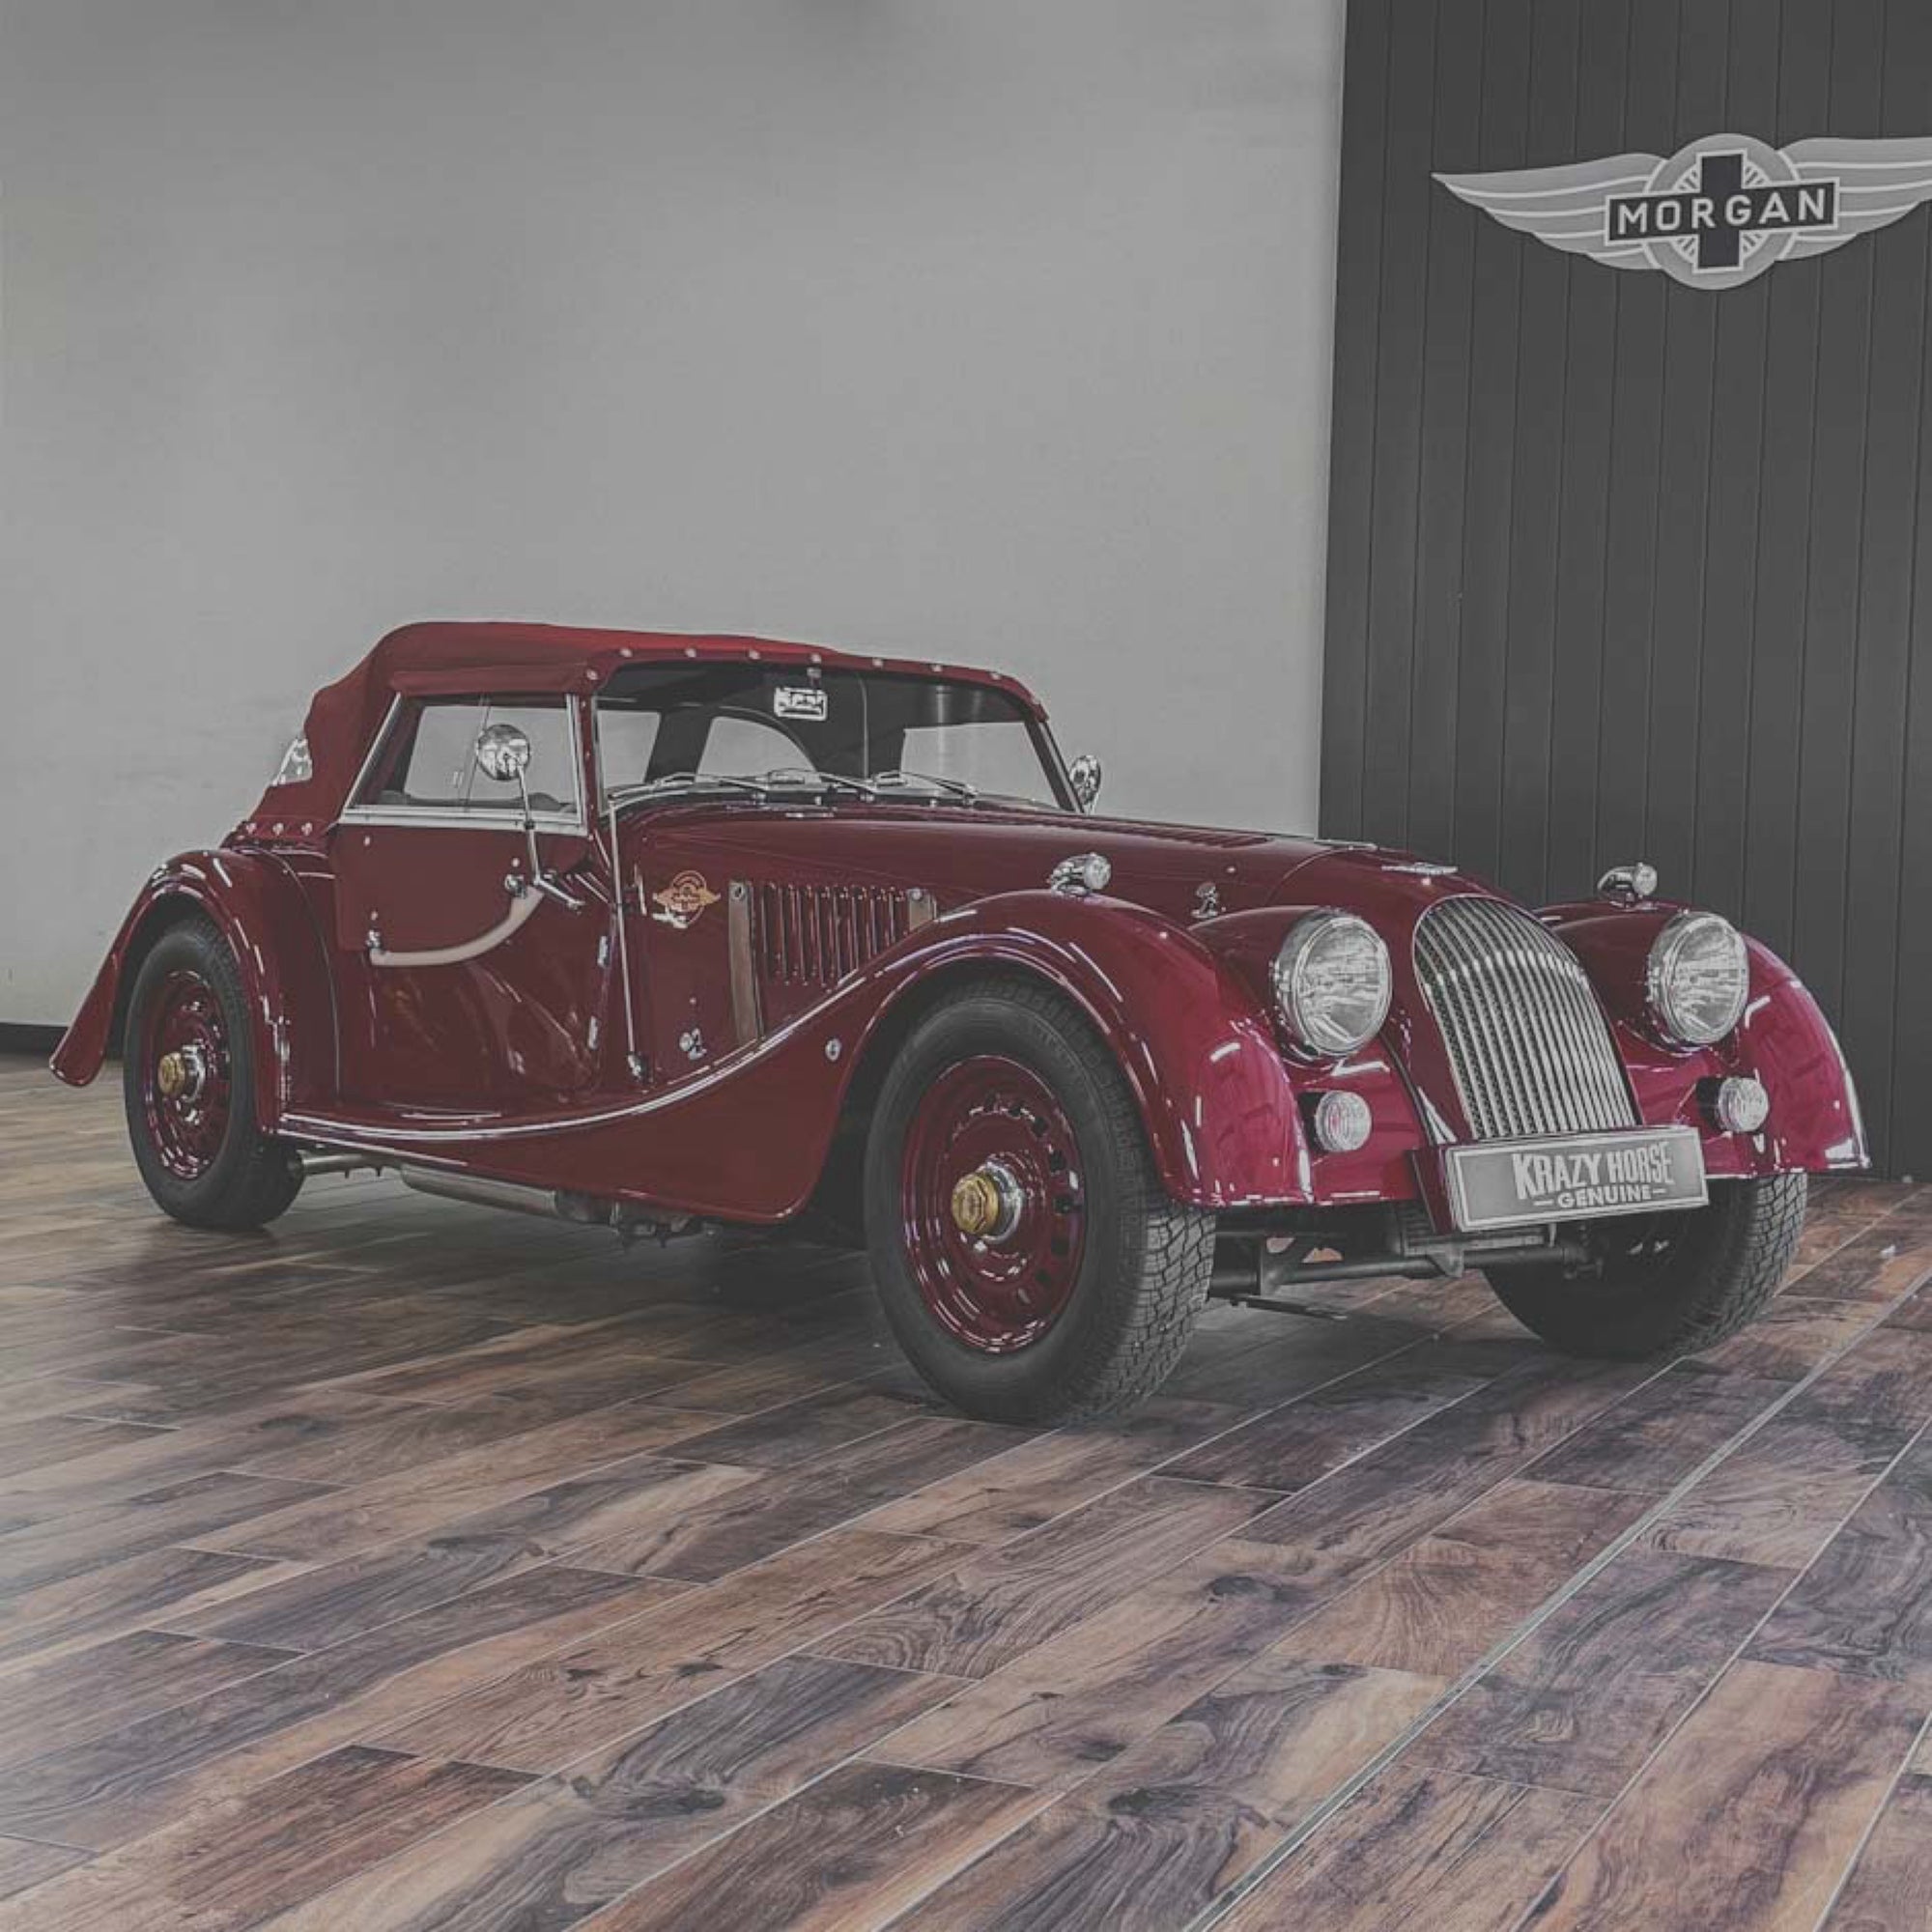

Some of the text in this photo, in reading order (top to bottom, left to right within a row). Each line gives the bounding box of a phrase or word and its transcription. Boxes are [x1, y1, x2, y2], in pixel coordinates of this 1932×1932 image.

[1618, 188, 1825, 235] MORGAN
[1512, 1141, 1674, 1200] KRAZY HORSE
